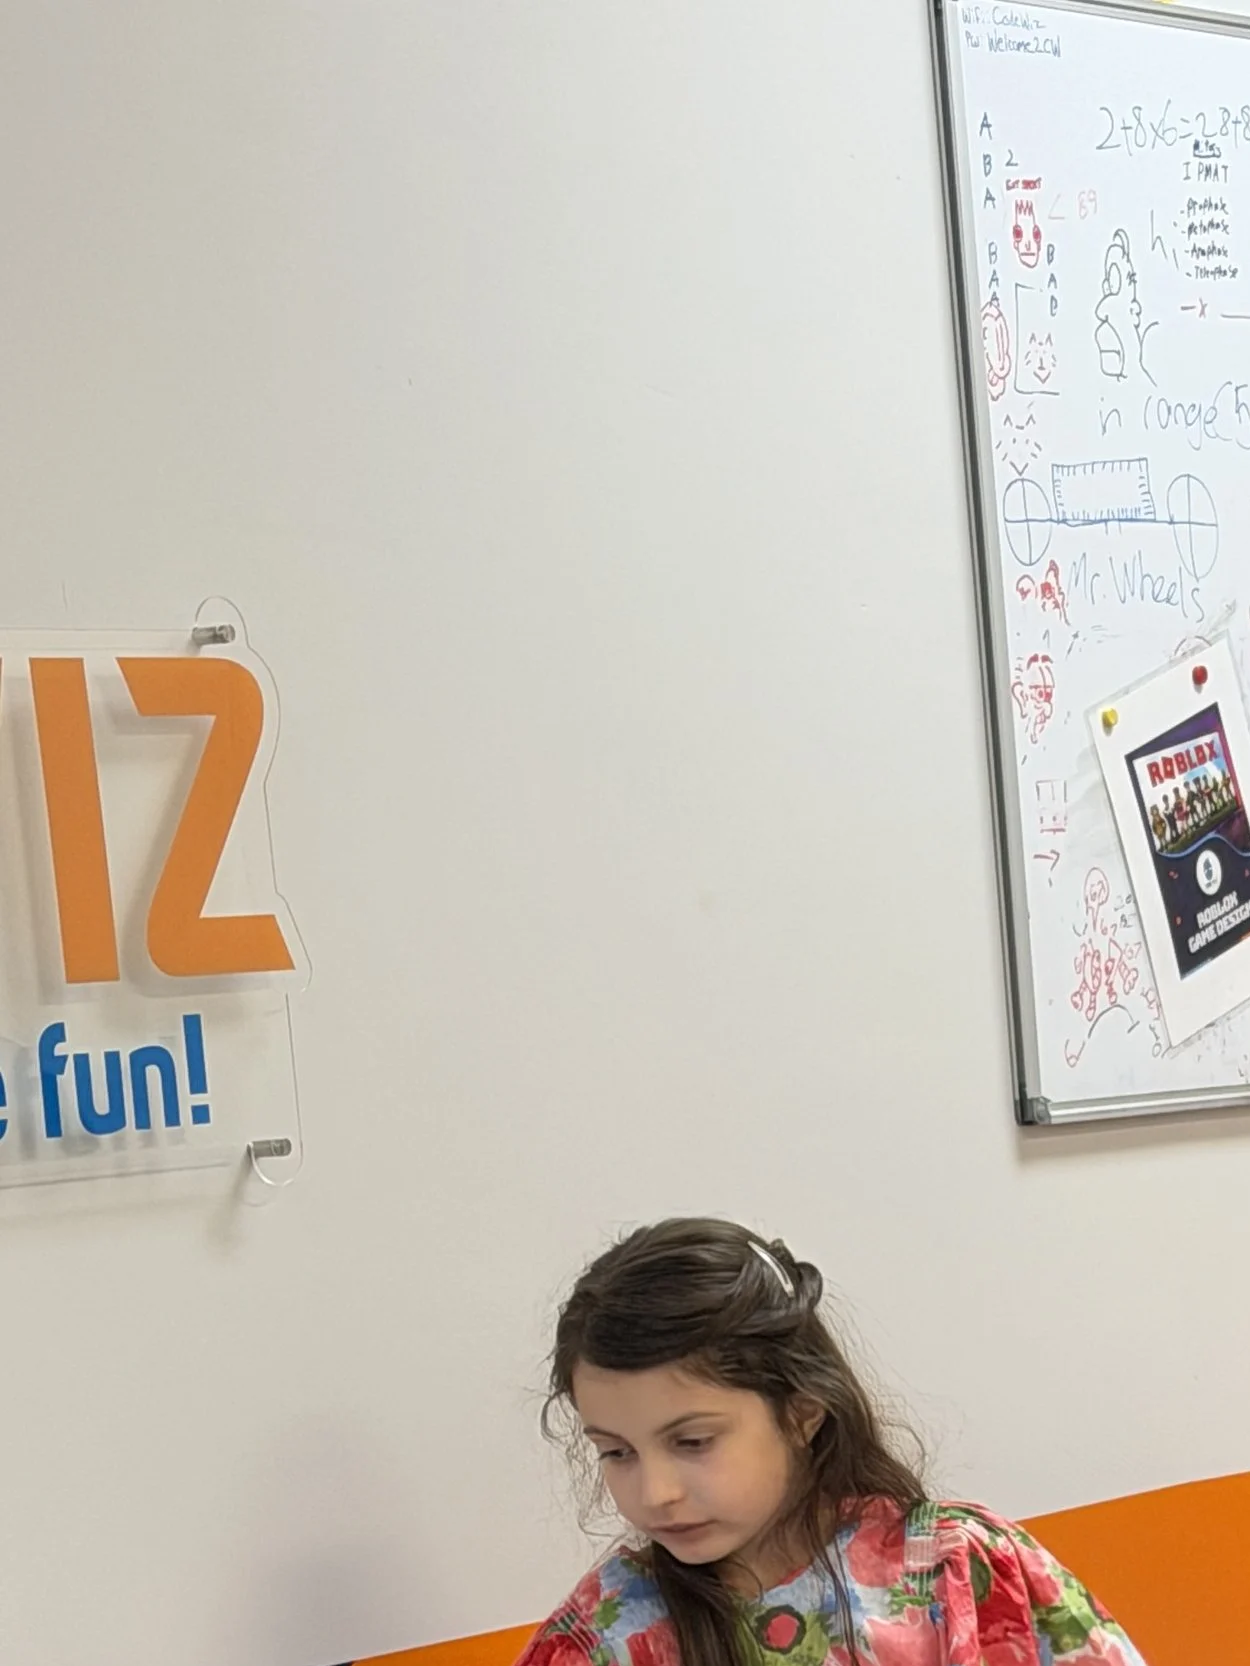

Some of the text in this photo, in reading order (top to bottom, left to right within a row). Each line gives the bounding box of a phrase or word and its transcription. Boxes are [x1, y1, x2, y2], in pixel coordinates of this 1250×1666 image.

[1147, 737, 1219, 789] ROBLOX
[0, 656, 296, 984] IZ
[1196, 890, 1239, 930] ROBLOX
[1188, 923, 1218, 954] GAME
[38, 1013, 212, 1139] fun!
